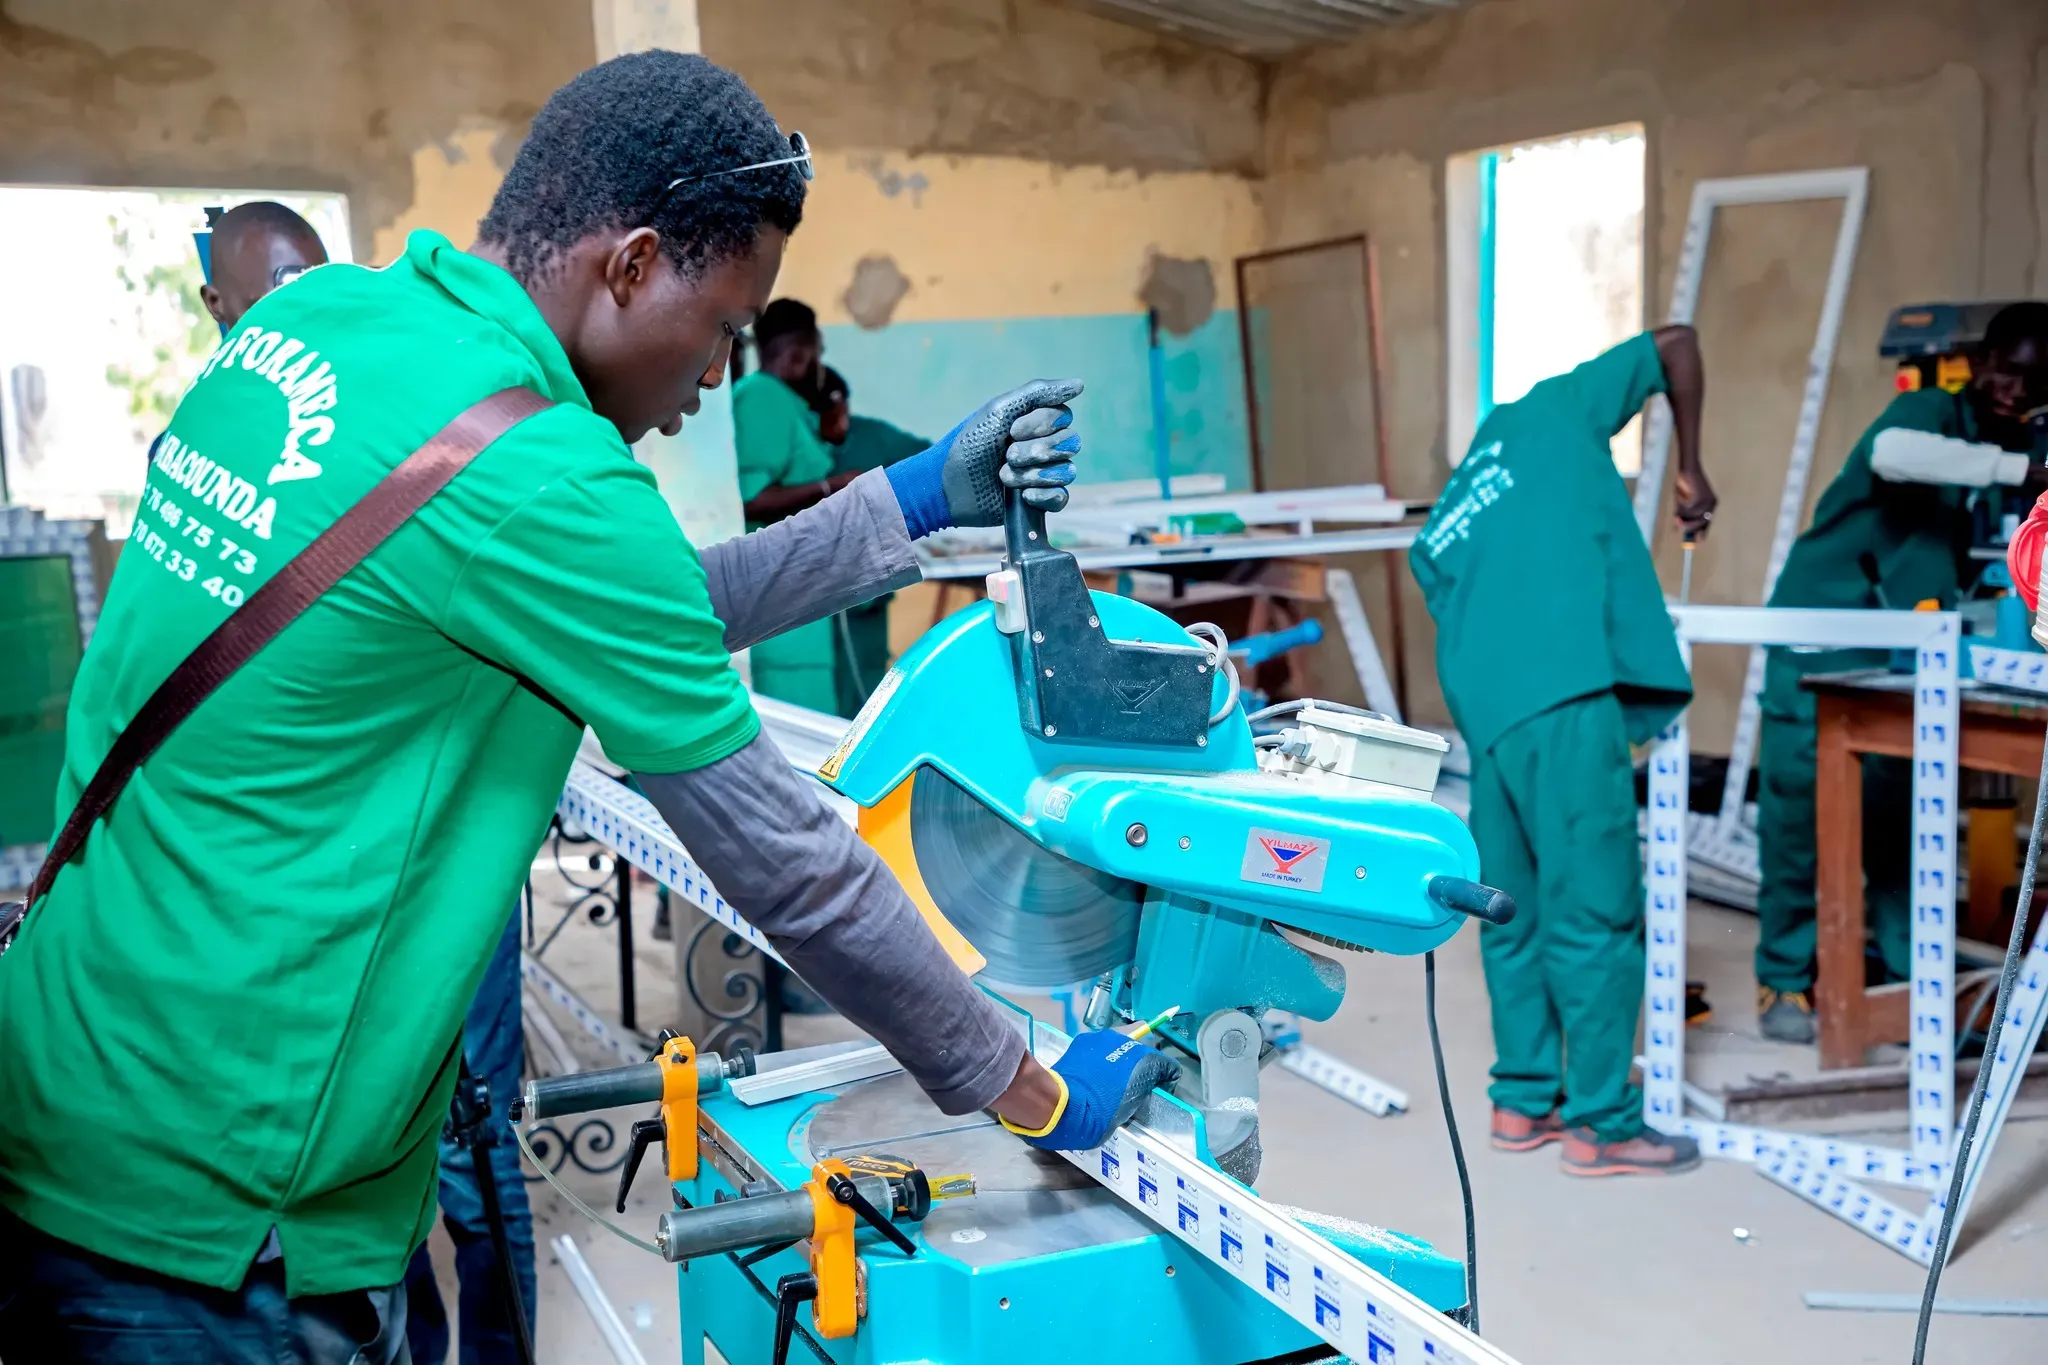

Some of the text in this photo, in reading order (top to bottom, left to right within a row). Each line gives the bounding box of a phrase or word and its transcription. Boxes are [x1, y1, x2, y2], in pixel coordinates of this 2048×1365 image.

[181, 516, 215, 547] 75
[218, 537, 257, 574] 73
[165, 549, 198, 581] 33
[201, 576, 244, 607] 40
